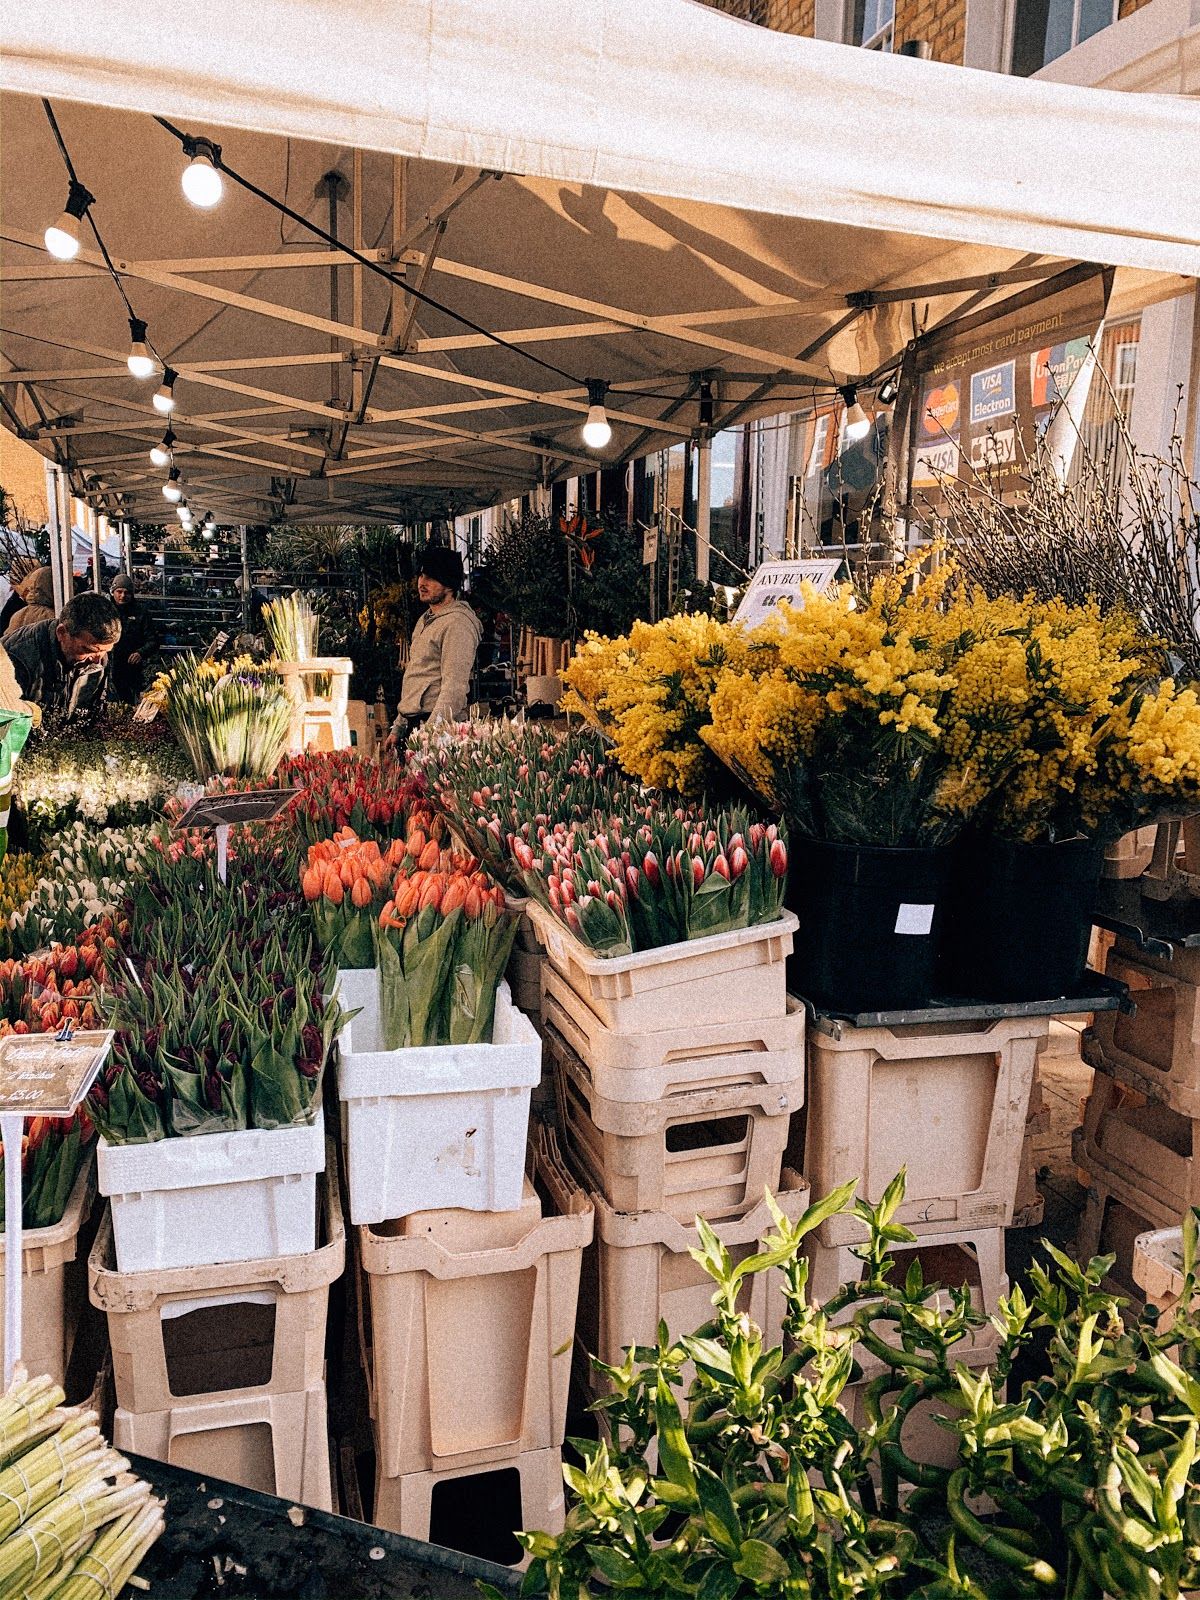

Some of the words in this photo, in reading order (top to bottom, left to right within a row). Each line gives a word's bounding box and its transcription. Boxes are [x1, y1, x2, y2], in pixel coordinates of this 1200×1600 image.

[933, 360, 945, 375] we
[945, 351, 971, 370] accept
[971, 341, 993, 360] most
[995, 331, 1016, 350] card
[1018, 312, 1064, 345] payment
[981, 372, 1002, 390] VISA
[974, 397, 1011, 417] Electron
[985, 436, 1014, 461] Pay
[757, 574, 781, 585] ANY
[7, 1088, 44, 1101] £5.00
